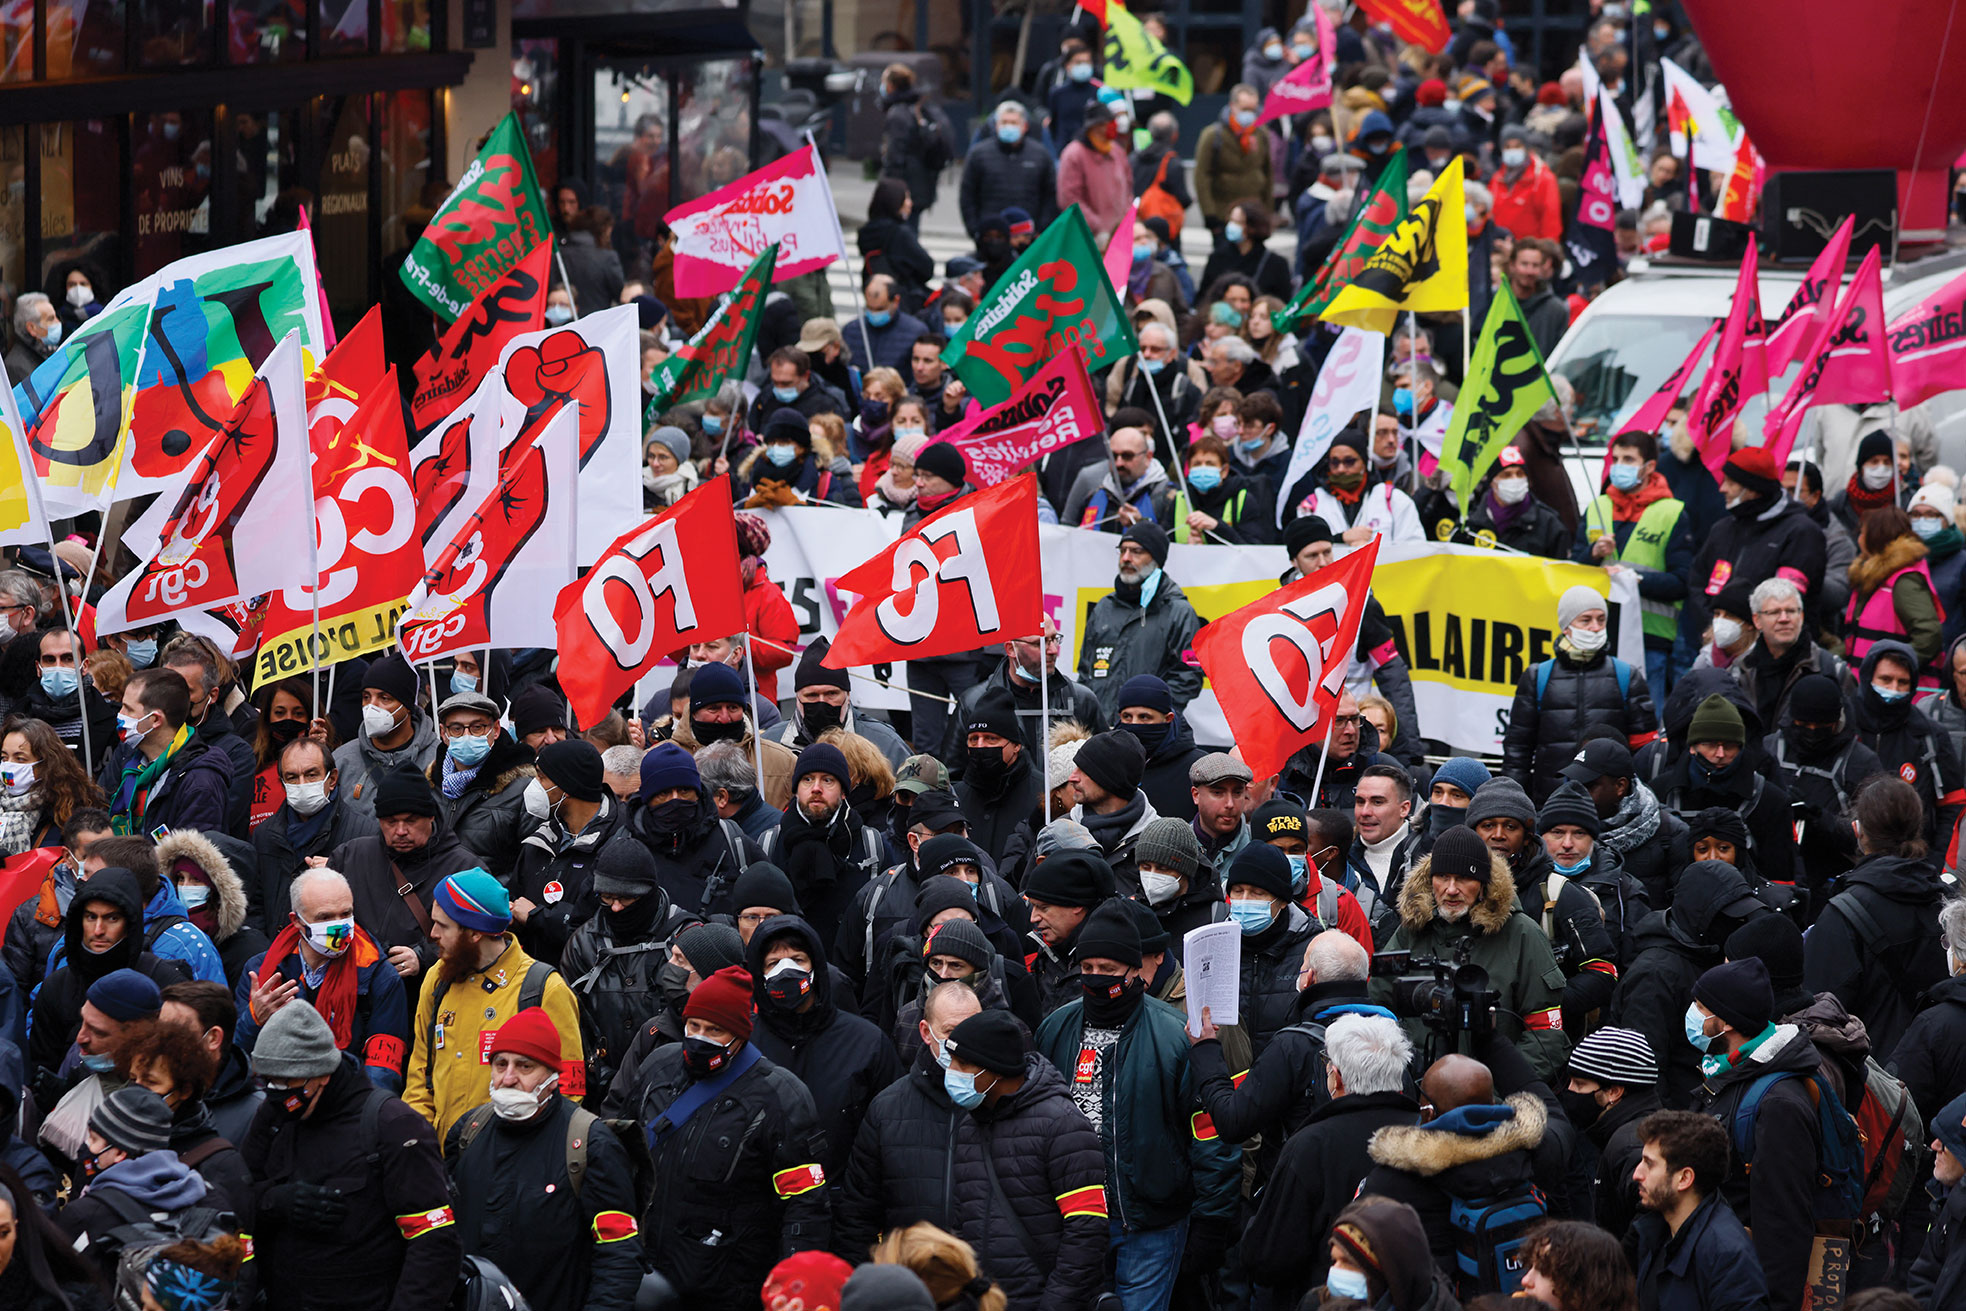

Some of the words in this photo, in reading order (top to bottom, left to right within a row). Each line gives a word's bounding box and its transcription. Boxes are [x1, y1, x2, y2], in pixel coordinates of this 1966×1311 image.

[159, 167, 184, 189] VINS
[138, 214, 151, 235] DE
[1390, 611, 1562, 686] ALAIRE
[1901, 765, 1916, 781] FO
[1266, 821, 1302, 834] WARS
[1270, 816, 1300, 825] STAR
[939, 859, 954, 871] Black
[1109, 985, 1122, 995] cgt
[1550, 1018, 1562, 1029] cg
[1078, 1060, 1094, 1075] cgt
[1823, 1246, 1843, 1311] PROTO
